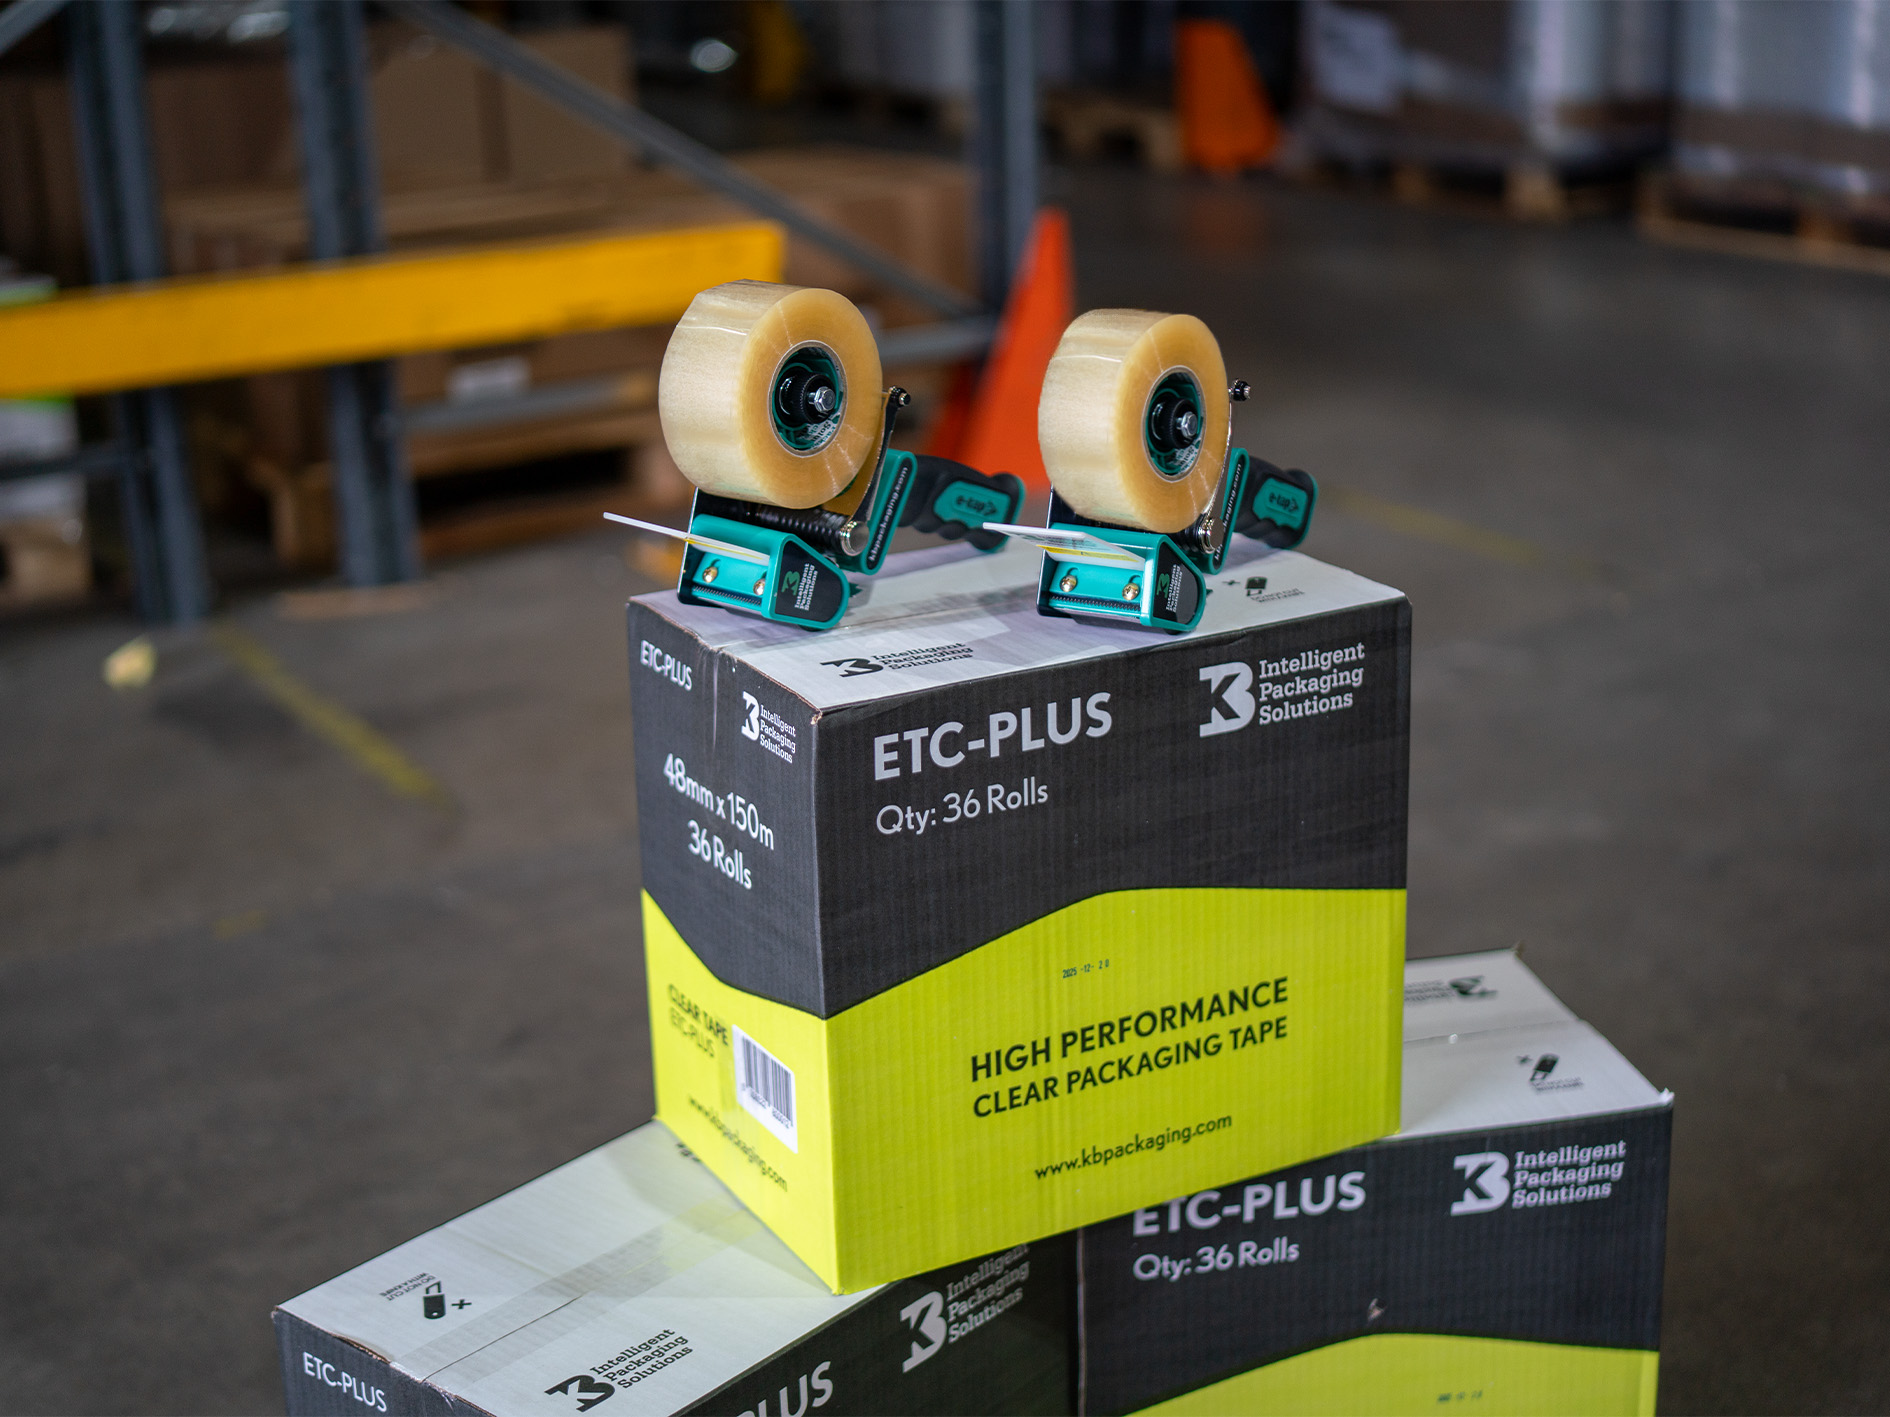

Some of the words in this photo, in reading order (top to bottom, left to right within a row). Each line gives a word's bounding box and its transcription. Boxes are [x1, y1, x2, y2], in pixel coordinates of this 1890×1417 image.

[868, 466, 908, 562] kbpackaging.com
[794, 563, 810, 608] Intelligent
[799, 564, 815, 610] Packaging
[804, 570, 818, 611] Solutions
[640, 640, 692, 691] ETC-PLUS
[871, 642, 966, 661] Intelligent
[877, 647, 974, 665] Packaging
[888, 653, 973, 670] Solutions
[1258, 641, 1366, 679] Intelligent
[1258, 667, 1364, 702] Packaging
[760, 704, 796, 737] Intelligent
[1258, 692, 1354, 725] Solutions
[760, 719, 796, 753] Packaging
[760, 733, 793, 764] Solutions
[873, 692, 1112, 781] ETC-PLUS
[663, 753, 714, 809] 48mm
[715, 798, 725, 819] x
[727, 791, 775, 850] 150m
[876, 804, 937, 836] Qty:
[943, 789, 981, 823] 36
[988, 776, 1049, 814] Rolls
[687, 819, 712, 863] 36
[713, 834, 752, 890] Rolls
[668, 984, 702, 1024] CLEAR
[702, 1010, 729, 1046] TAPE
[970, 1036, 1051, 1083] HIGH
[1061, 976, 1289, 1059] PERFORMANCE
[973, 1076, 1060, 1118] CLEAR
[1066, 1033, 1223, 1095] PACKAGING
[1229, 1015, 1288, 1050] TAPE
[1034, 1115, 1233, 1181] www.kbpackaging.com
[1514, 1139, 1627, 1170] Intelligent
[1511, 1182, 1613, 1209] Solutions
[1513, 1161, 1625, 1189] Packaging
[1132, 1171, 1367, 1237] ETC-PLUS
[946, 1243, 1030, 1301] Intelligent
[1133, 1253, 1192, 1282] Qty:
[1194, 1244, 1234, 1273] 36
[1238, 1236, 1300, 1268] Rolls
[947, 1261, 1030, 1323] Packaging
[948, 1287, 1023, 1344] Solutions
[589, 1328, 675, 1375] Intelligent
[603, 1336, 688, 1381] Packaging
[617, 1346, 693, 1389] Solutions
[303, 1351, 387, 1412] ETC-PLUS
